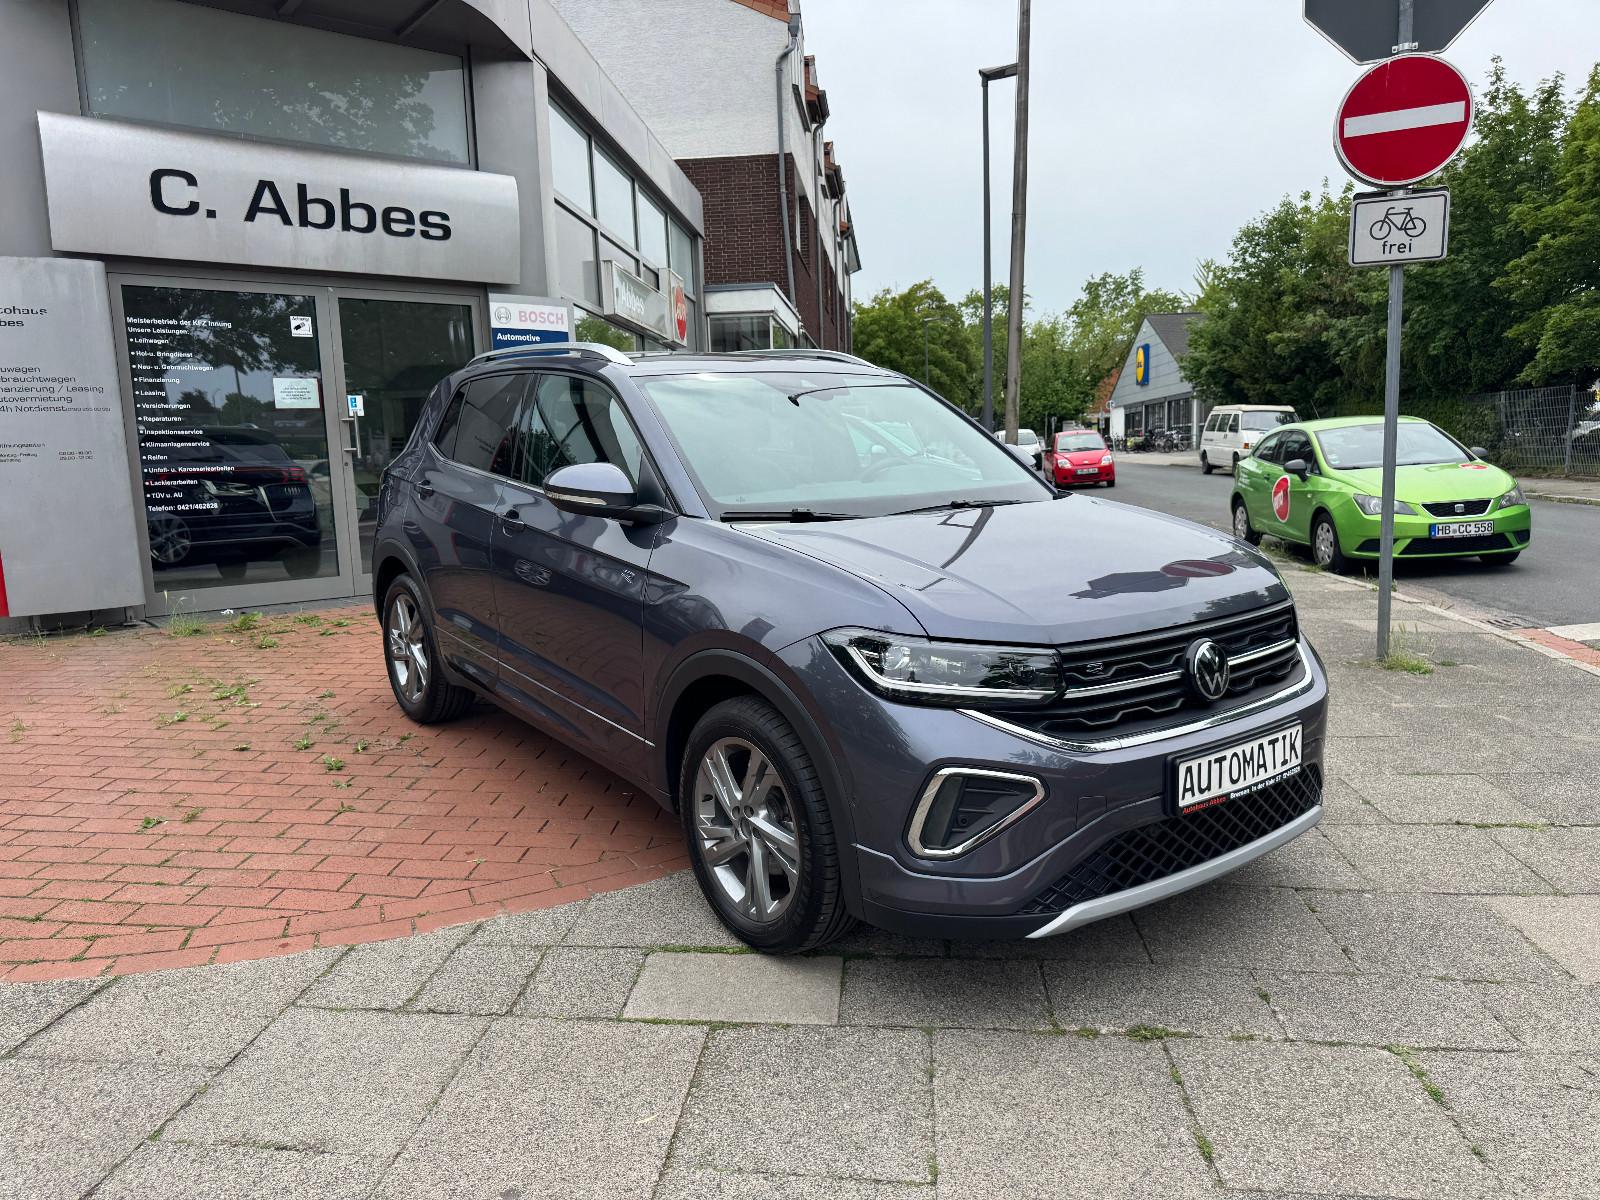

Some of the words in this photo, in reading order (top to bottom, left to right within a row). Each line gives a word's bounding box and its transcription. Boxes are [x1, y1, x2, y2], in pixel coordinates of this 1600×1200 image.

[149, 168, 217, 218] C.
[243, 179, 452, 241] Abbes
[1382, 239, 1413, 255] frei
[126, 316, 178, 325] Meisterbetrieb
[208, 320, 232, 329] Innung
[518, 310, 565, 325] BOSCH
[496, 333, 541, 342] Automotive
[161, 364, 214, 372] Gebrauchtwagen
[138, 376, 180, 384] Finanzierung
[57, 384, 64, 393] /
[66, 385, 104, 394] Leasing
[15, 404, 66, 413] Notdienst
[1437, 525, 1451, 535] HB
[1458, 524, 1472, 534] CC
[1474, 522, 1493, 533] 558
[1181, 728, 1300, 801] AUTOMATIK
[1230, 789, 1250, 799] Bremen
